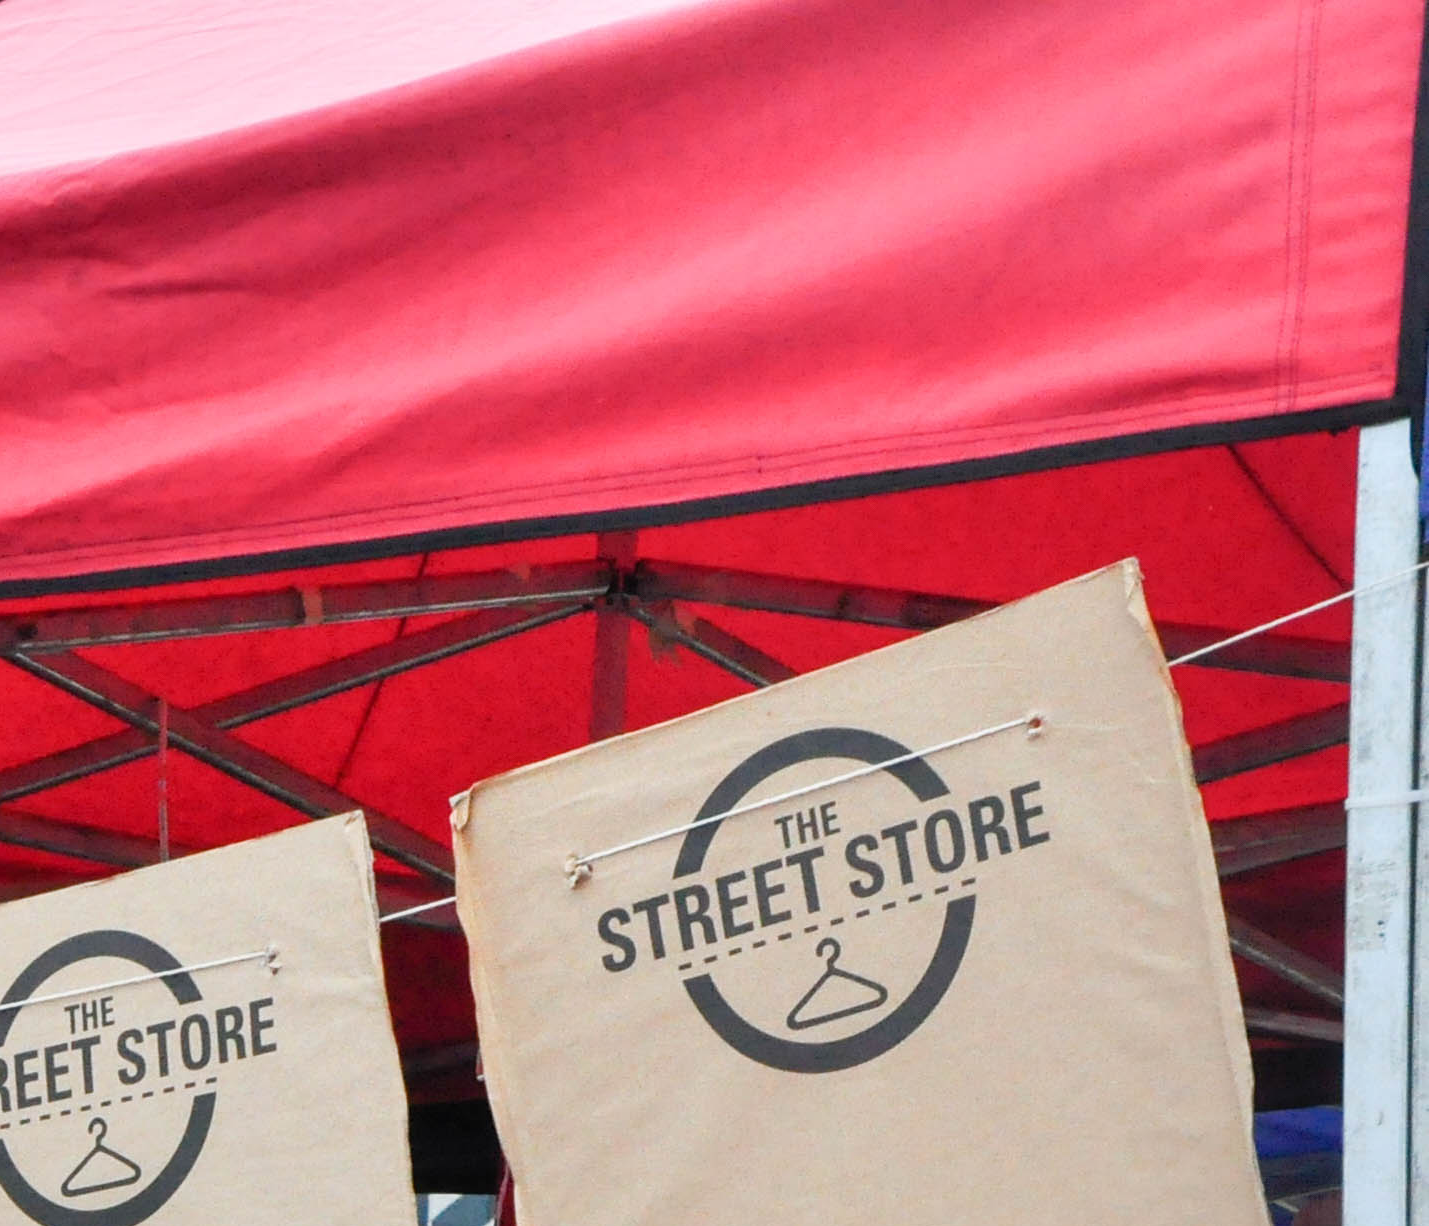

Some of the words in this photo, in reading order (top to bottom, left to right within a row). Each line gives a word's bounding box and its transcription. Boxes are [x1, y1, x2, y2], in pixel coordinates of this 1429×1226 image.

[774, 801, 841, 849] THE
[596, 847, 825, 973] STREET
[845, 780, 1050, 899] STORE
[64, 997, 115, 1034] THE
[117, 998, 278, 1085] STORE
